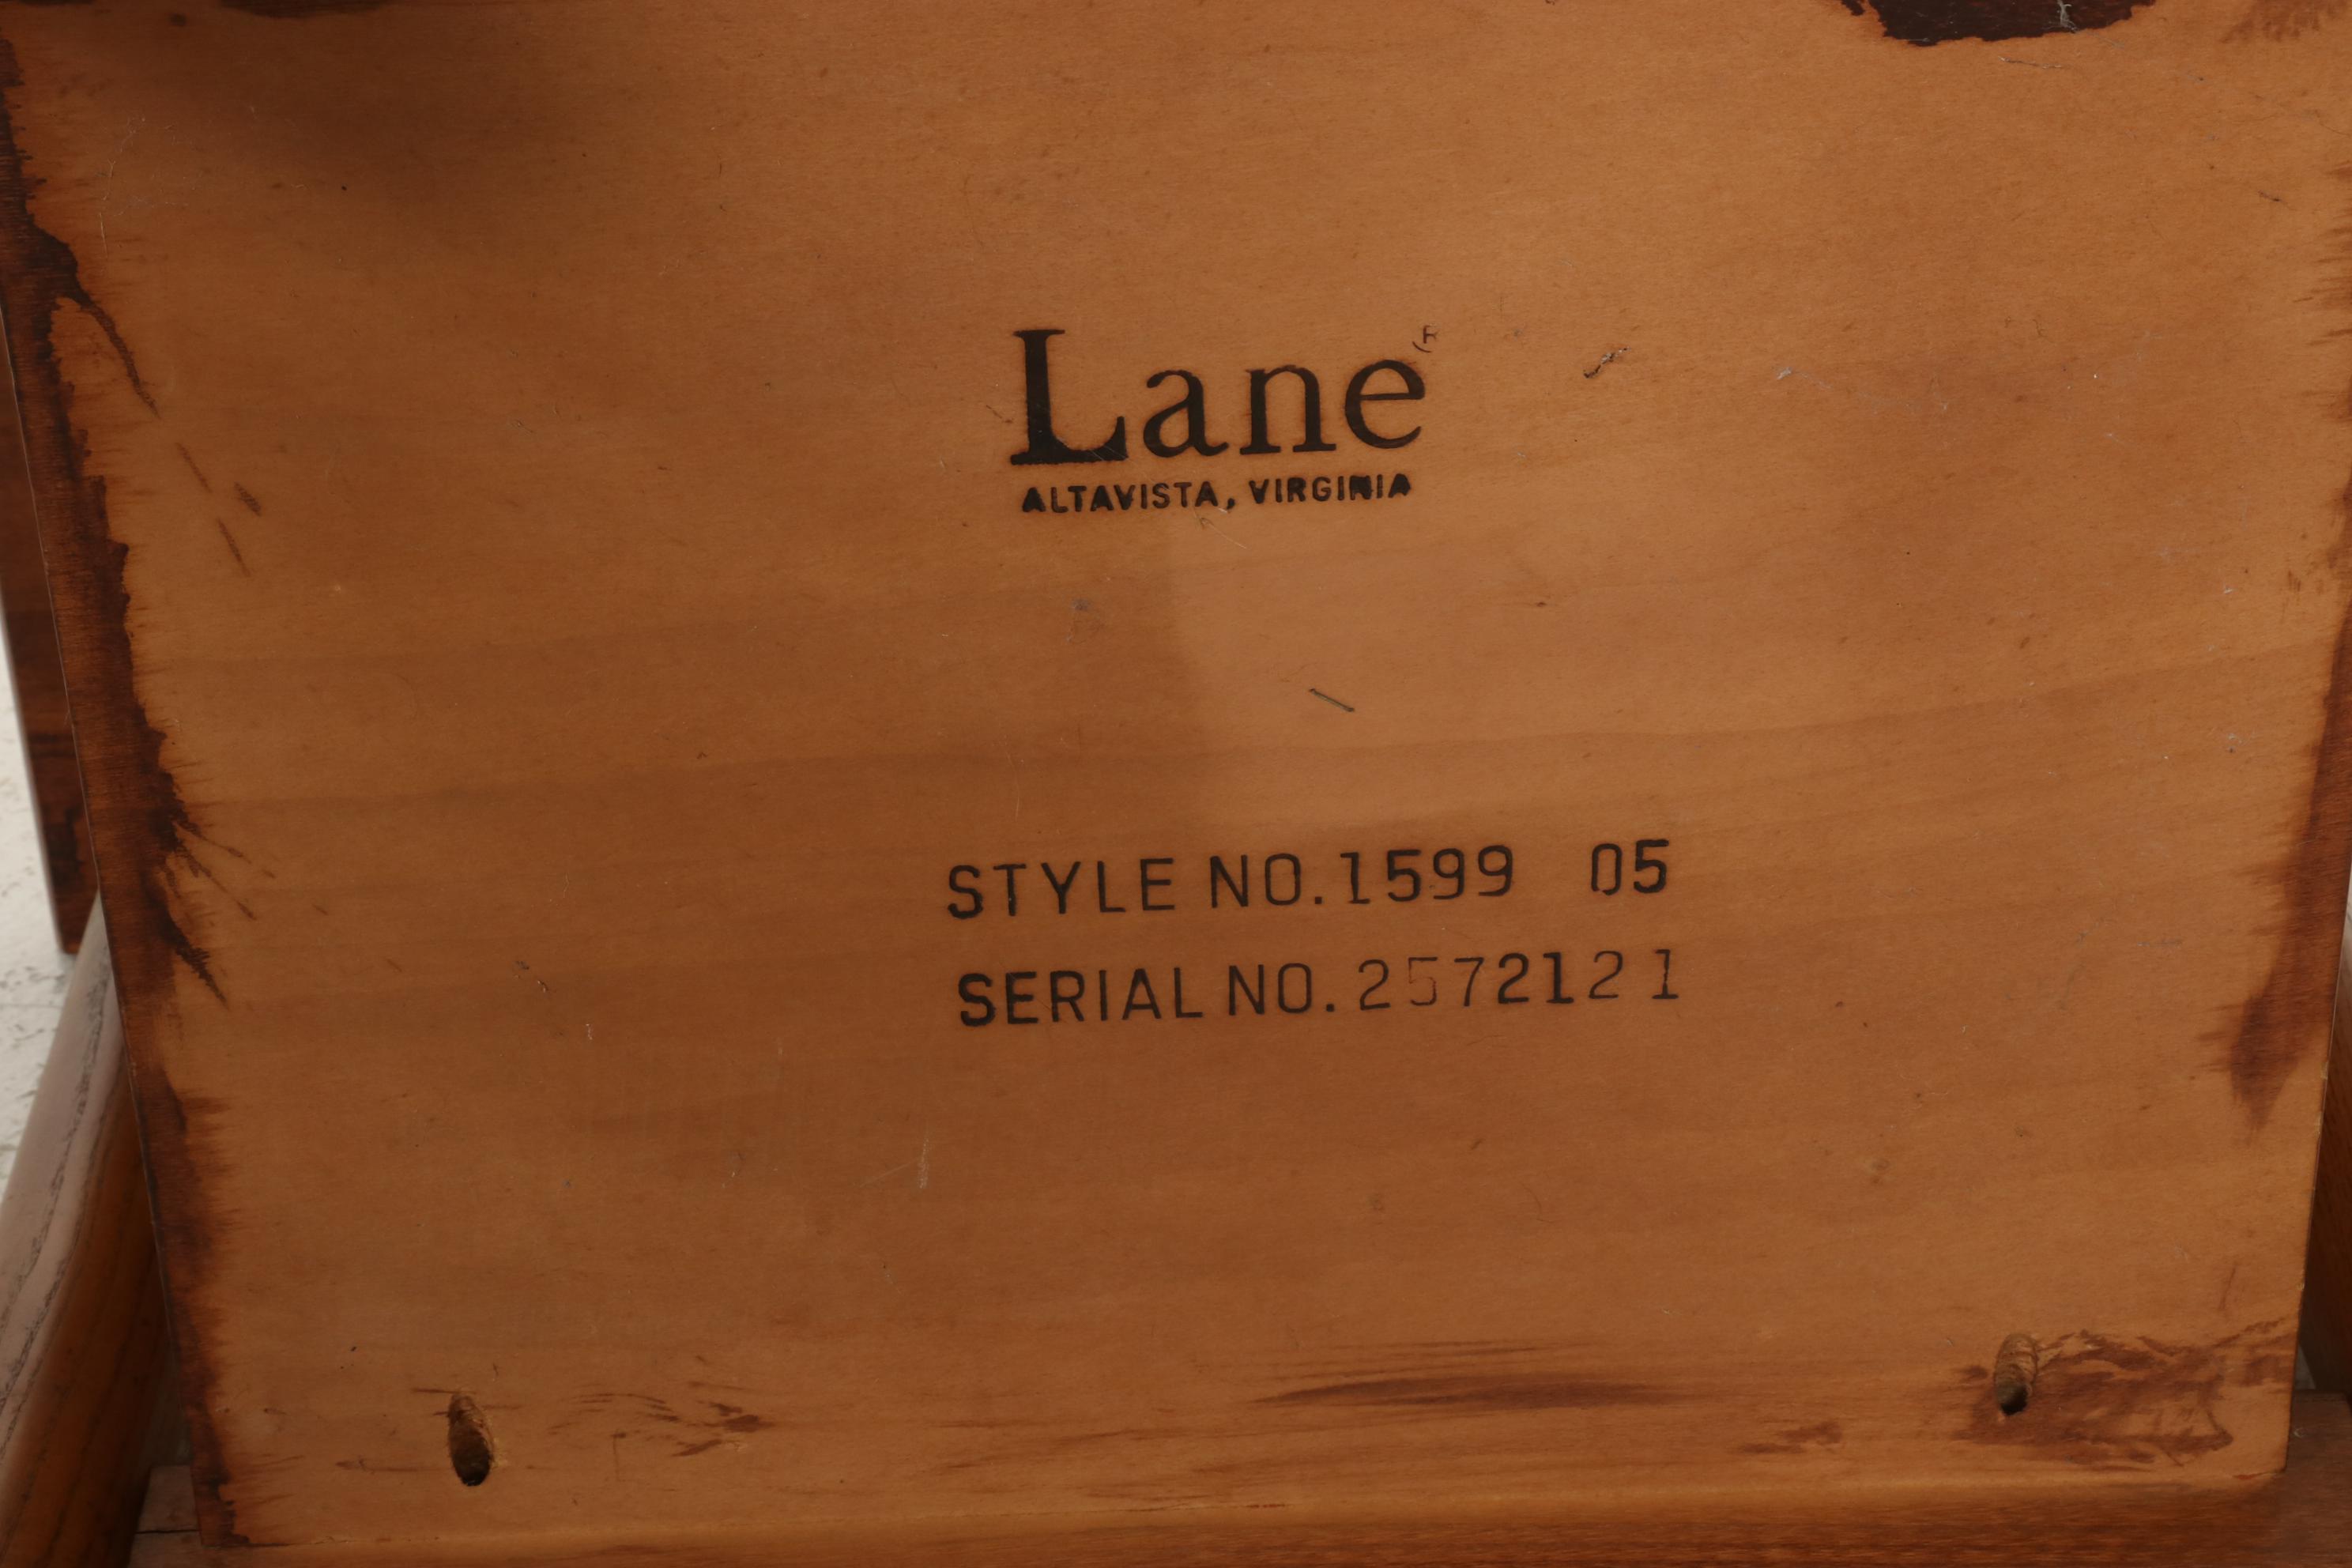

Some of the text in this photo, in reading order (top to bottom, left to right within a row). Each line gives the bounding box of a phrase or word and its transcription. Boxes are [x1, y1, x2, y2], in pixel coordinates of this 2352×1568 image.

[1009, 329, 1426, 466] Lane
[1020, 472, 1413, 514] ALTAVISTA, VIRGINIA
[947, 854, 1176, 921] STYLE
[1589, 838, 1671, 897] 05
[957, 966, 1203, 1028] SERIAL
